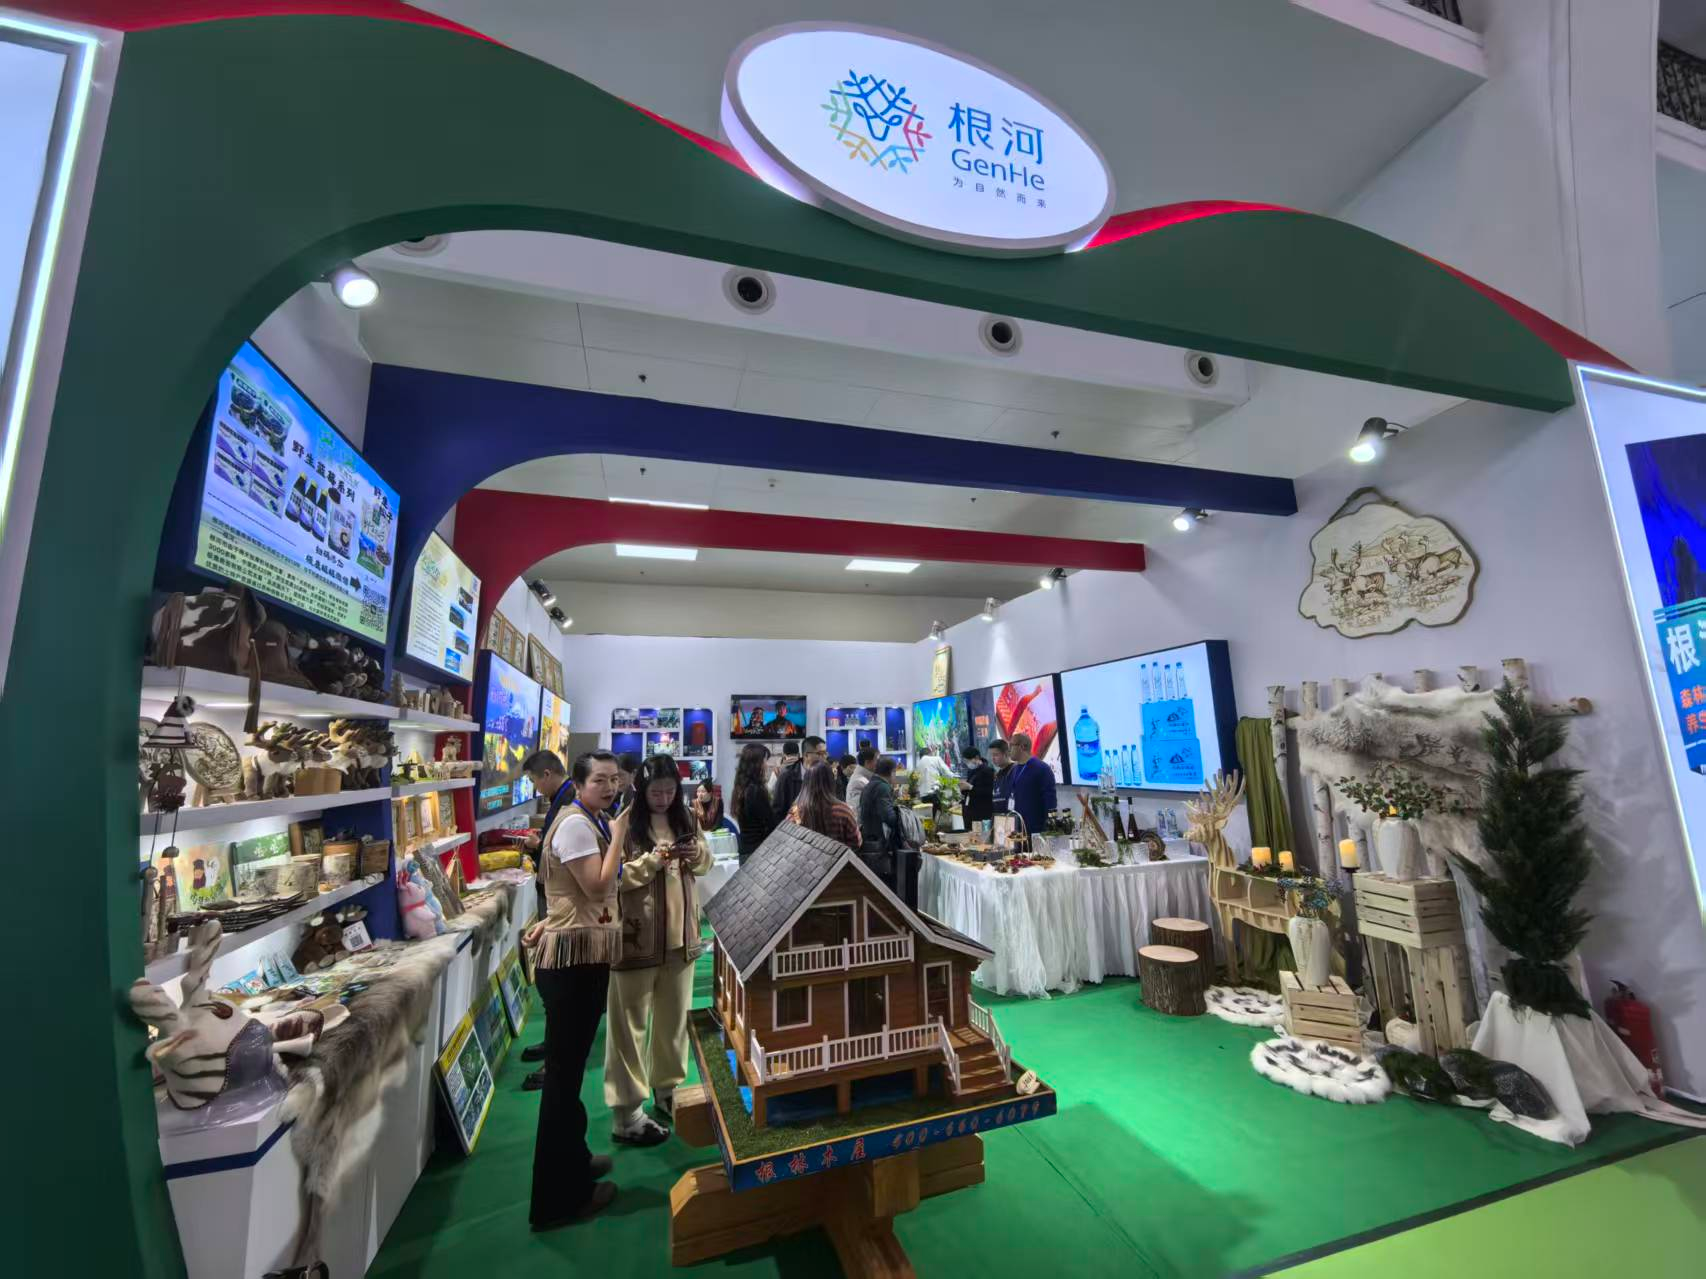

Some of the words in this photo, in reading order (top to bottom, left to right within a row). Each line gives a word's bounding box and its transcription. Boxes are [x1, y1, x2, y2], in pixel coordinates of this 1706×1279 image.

[948, 102, 1045, 165] 根河
[951, 147, 1046, 191] GenHe
[952, 176, 1047, 209] 为自然而来
[1666, 619, 1706, 675] 根
